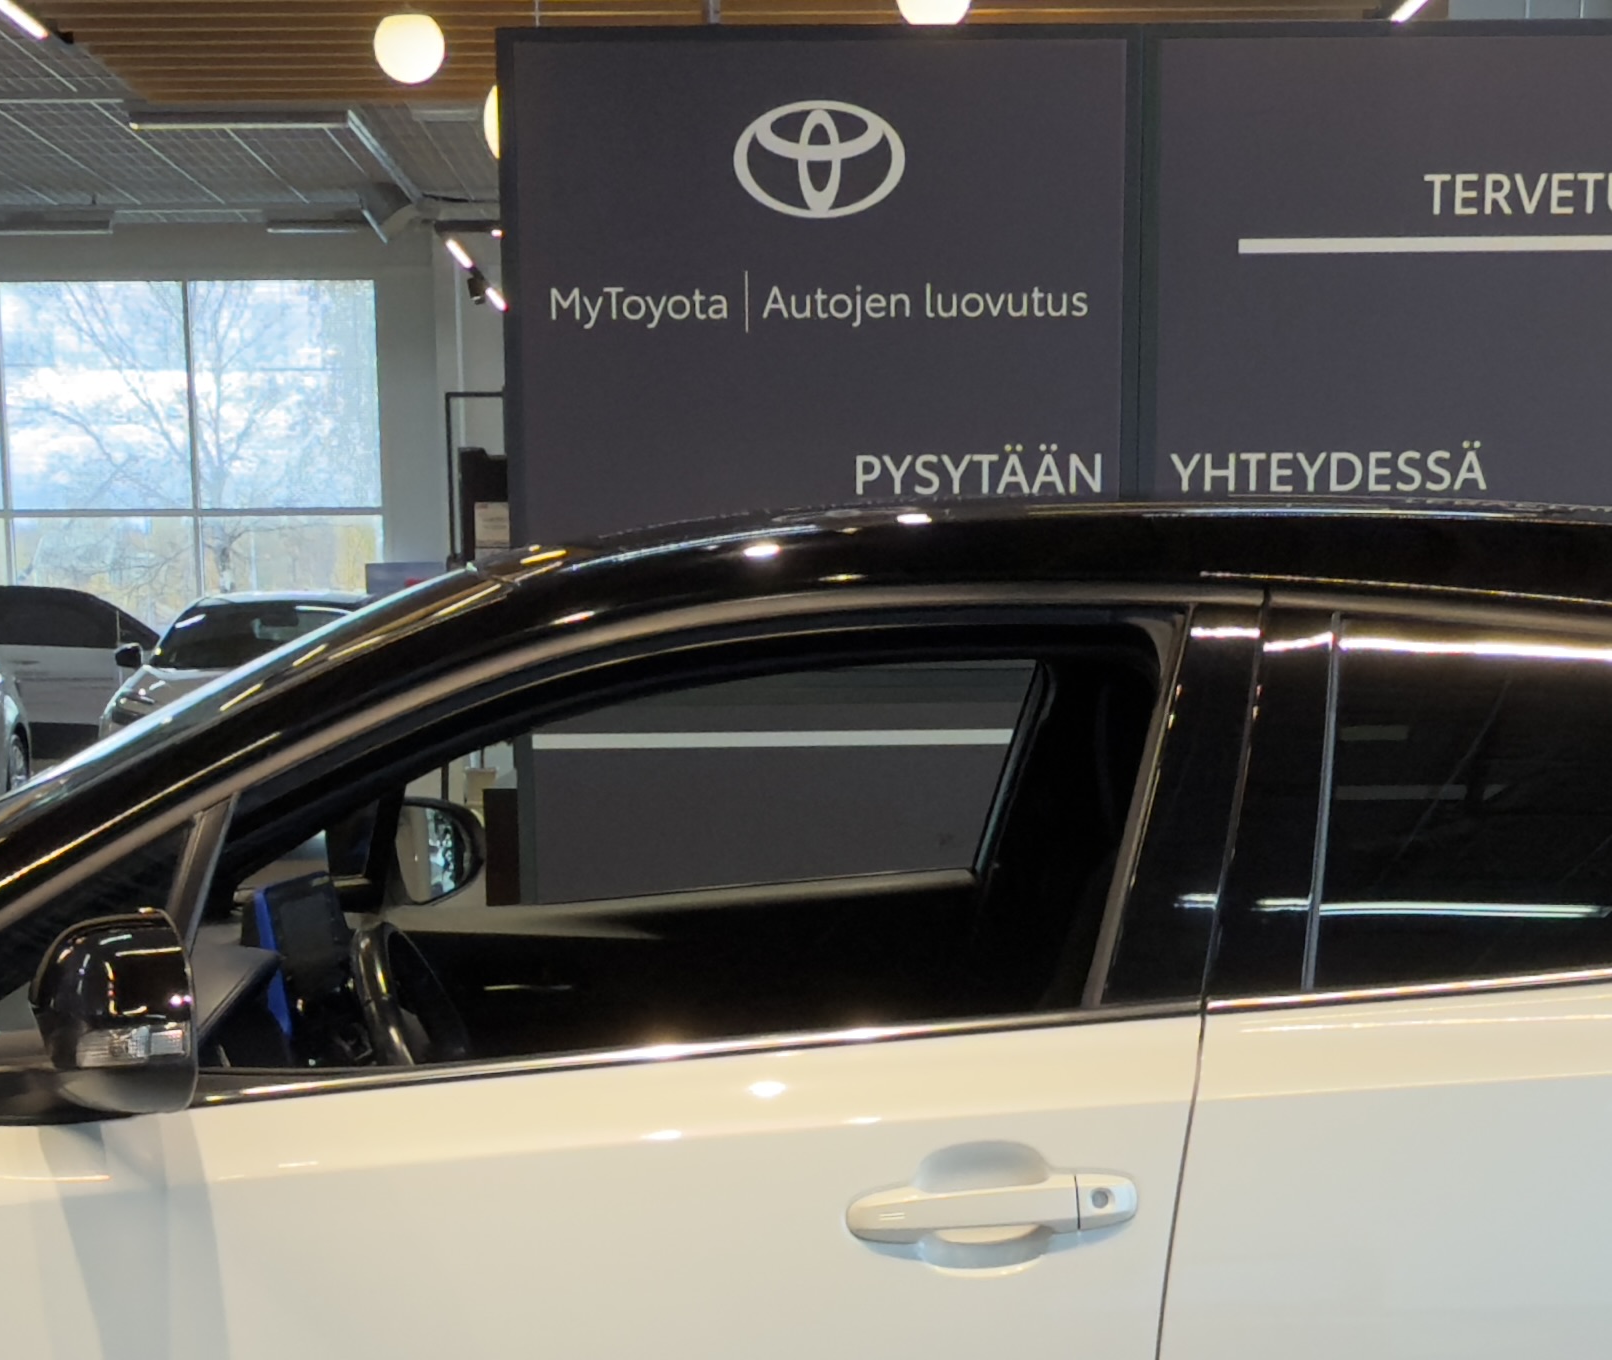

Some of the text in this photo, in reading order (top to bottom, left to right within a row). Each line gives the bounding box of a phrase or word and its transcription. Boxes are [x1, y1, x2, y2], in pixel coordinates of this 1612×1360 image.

[549, 282, 1089, 330] MyToyota Autojen luovutus
[855, 440, 1488, 495] PYSYTÄÄN YHTEYDESSÄ
